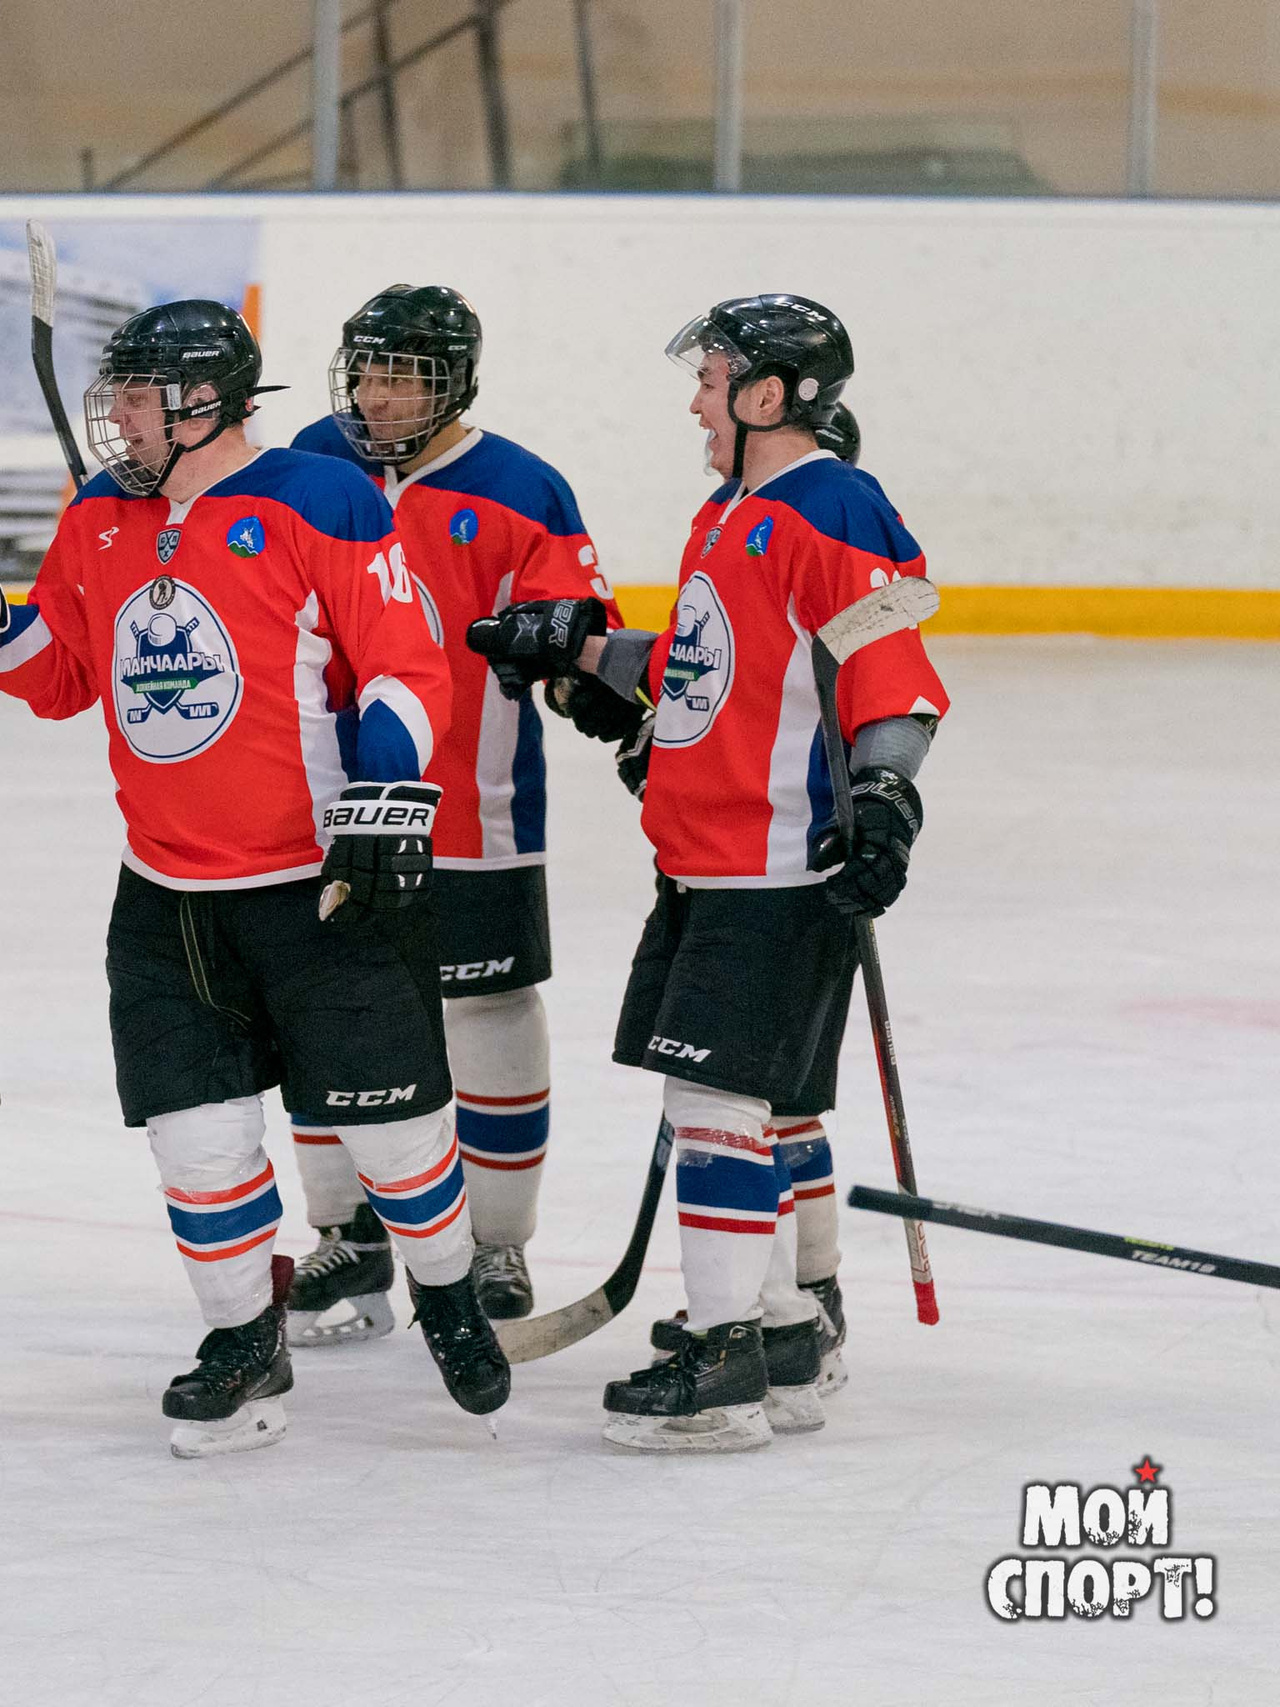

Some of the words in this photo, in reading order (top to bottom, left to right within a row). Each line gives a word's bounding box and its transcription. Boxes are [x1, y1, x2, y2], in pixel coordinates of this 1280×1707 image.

[353, 335, 385, 345] CCM
[182, 350, 220, 359] BAUER
[190, 400, 222, 416] BAUER
[367, 541, 413, 607] 16
[120, 652, 225, 680] МАНЧААРЫ
[323, 806, 430, 829] BAUER
[647, 1035, 712, 1063] CCM
[325, 1083, 417, 1107] CCM
